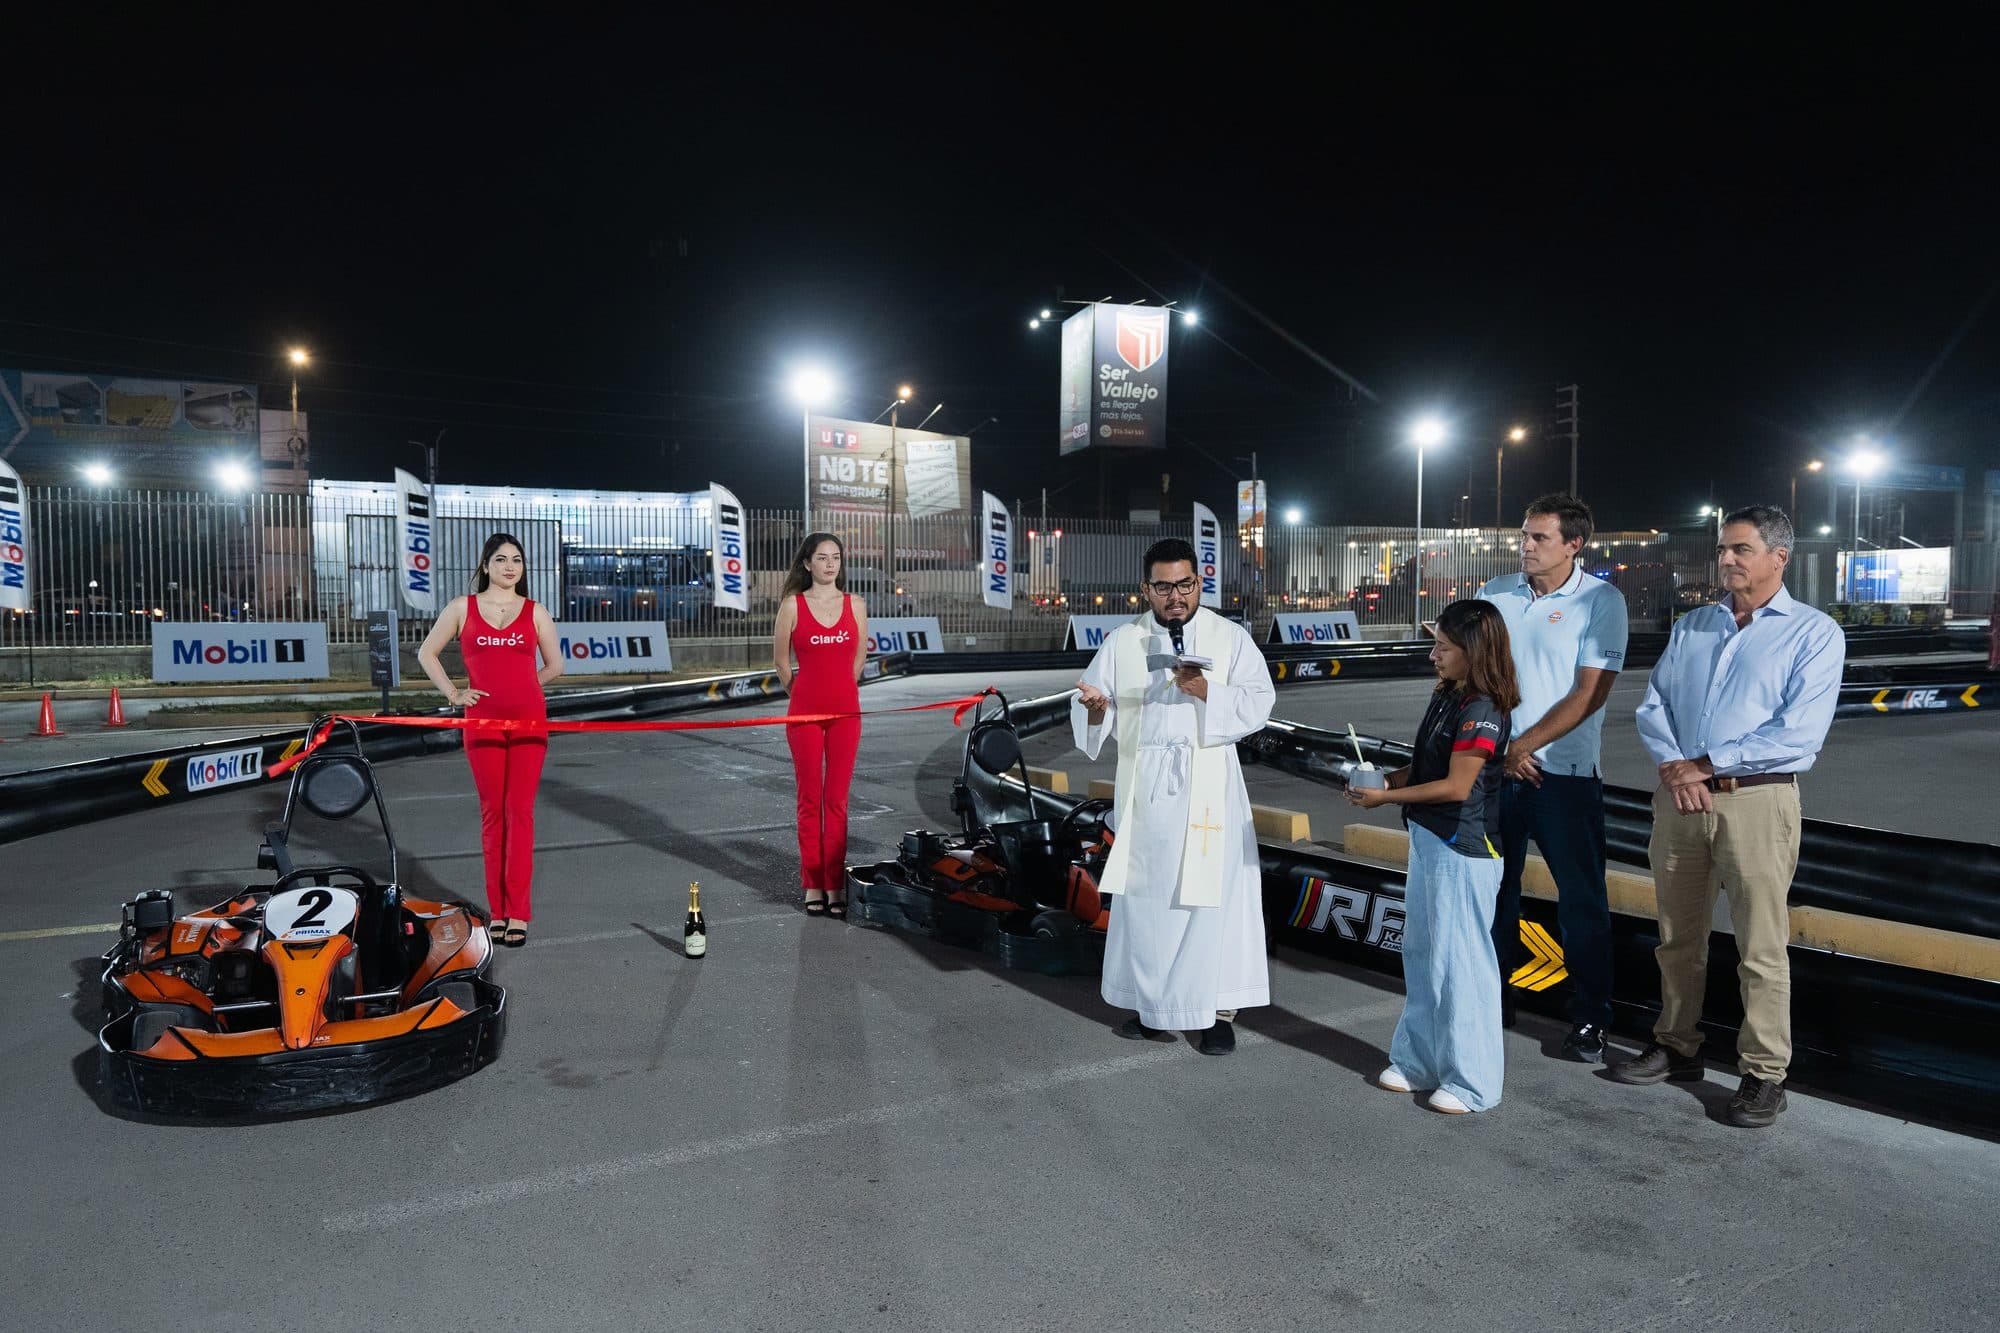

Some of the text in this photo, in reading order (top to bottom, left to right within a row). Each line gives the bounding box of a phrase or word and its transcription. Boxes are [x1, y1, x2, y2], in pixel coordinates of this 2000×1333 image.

[1100, 363, 1129, 380] Ser
[1100, 382, 1158, 402] Vallejo
[821, 430, 857, 445] UTP
[858, 459, 888, 484] TE
[408, 522, 430, 593] Mobil
[721, 530, 741, 593] Mobil
[991, 535, 1006, 593] Mobil
[1201, 541, 1216, 594] Mobil
[476, 635, 517, 646] Claro
[810, 635, 844, 645] Claro
[866, 632, 904, 652] obil
[1288, 623, 1334, 641] Mobil
[173, 639, 267, 665] Mobil
[189, 750, 240, 787] Mobil
[290, 889, 333, 929] 2
[1307, 881, 1406, 946] RF
